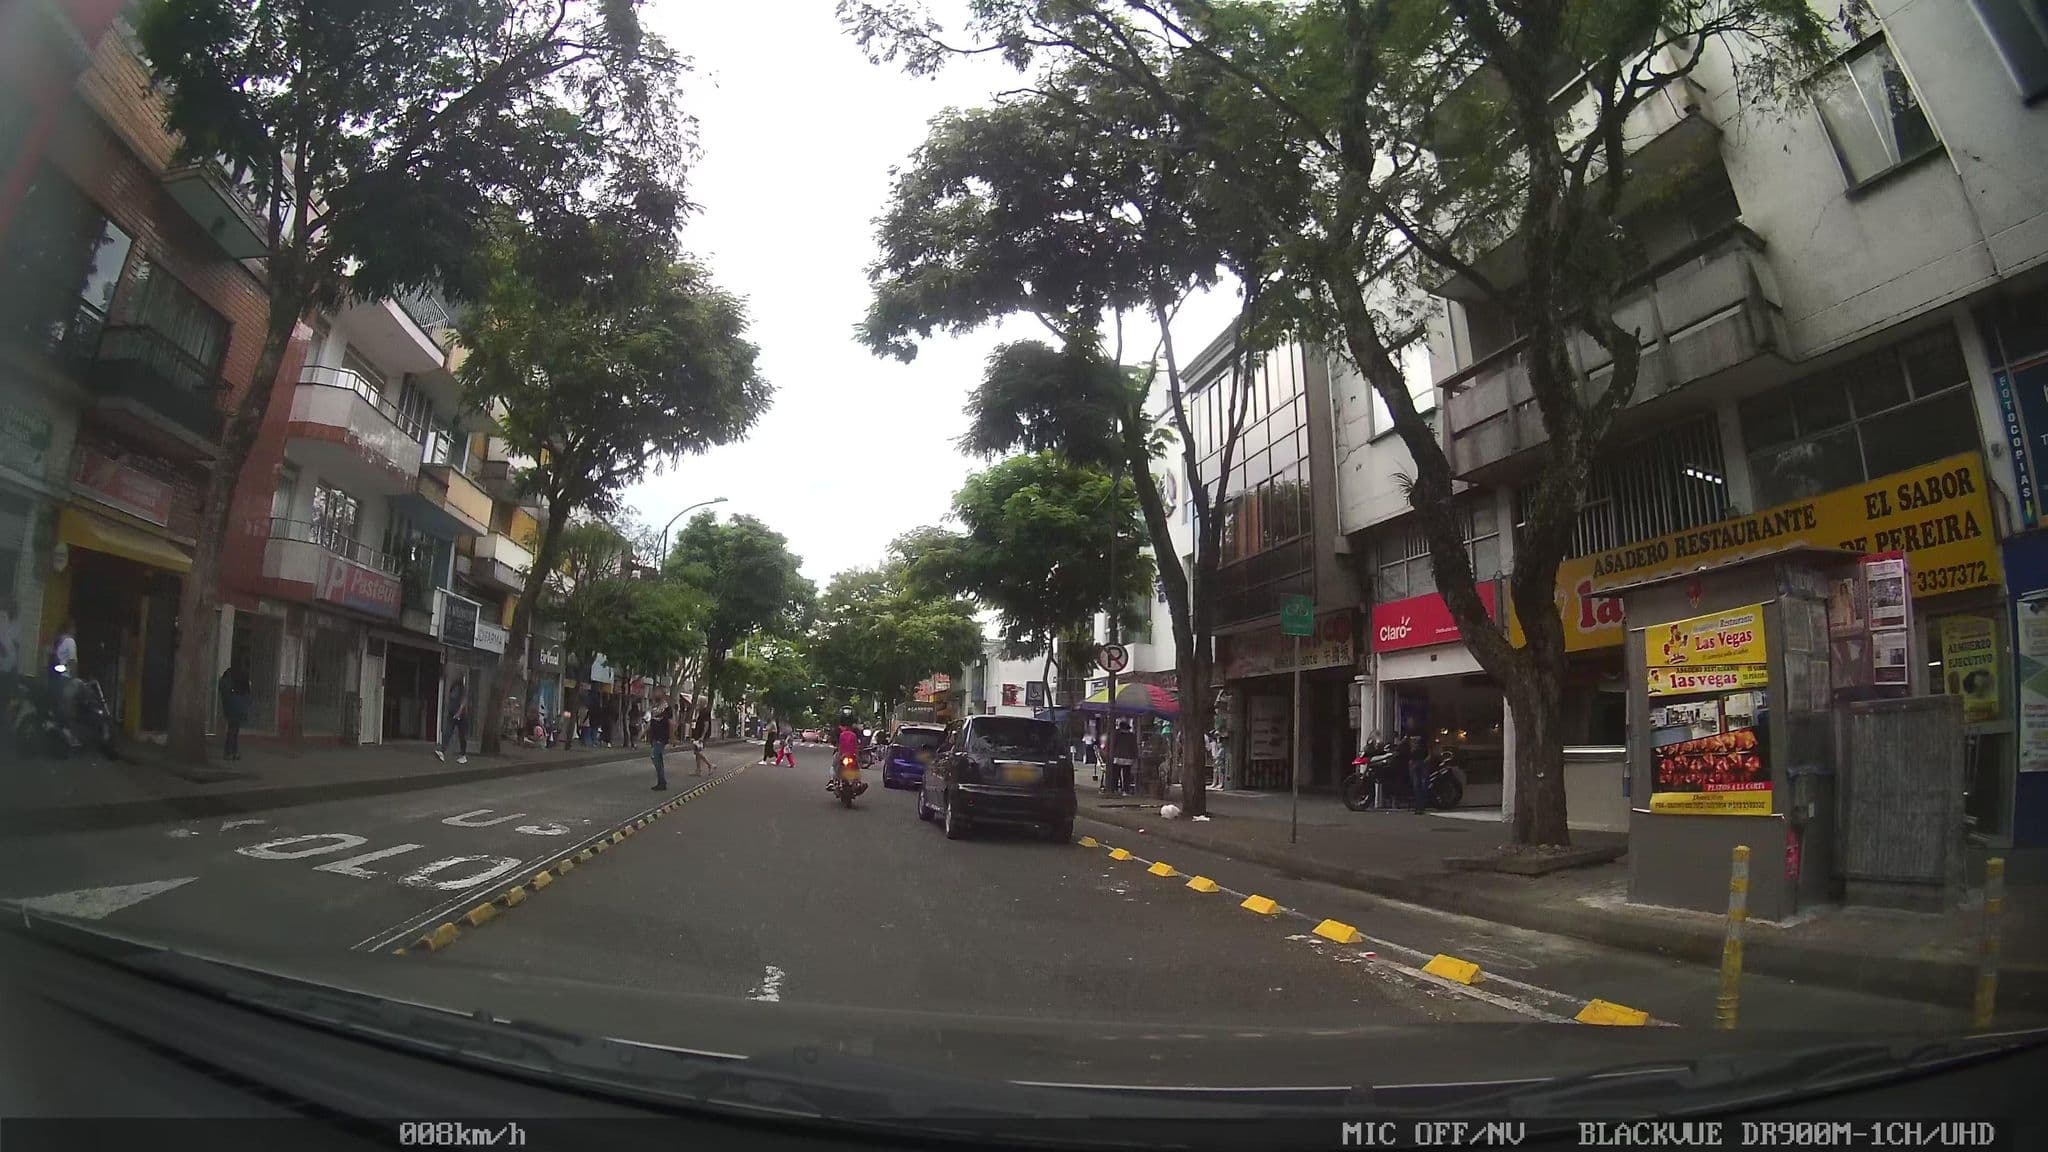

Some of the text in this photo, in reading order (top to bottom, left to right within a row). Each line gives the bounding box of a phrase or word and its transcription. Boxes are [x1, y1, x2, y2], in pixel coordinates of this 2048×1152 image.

[1593, 467, 1976, 578] ASADERO RESTAURANTE EL SABOR
[1874, 510, 1981, 553] PEREIRA
[1380, 621, 1409, 642] Claro
[1695, 630, 1752, 650] Las Vegas
[1948, 654, 1993, 668] EJECUTIVO
[1670, 673, 1694, 688] las
[1697, 673, 1737, 687] vegas
